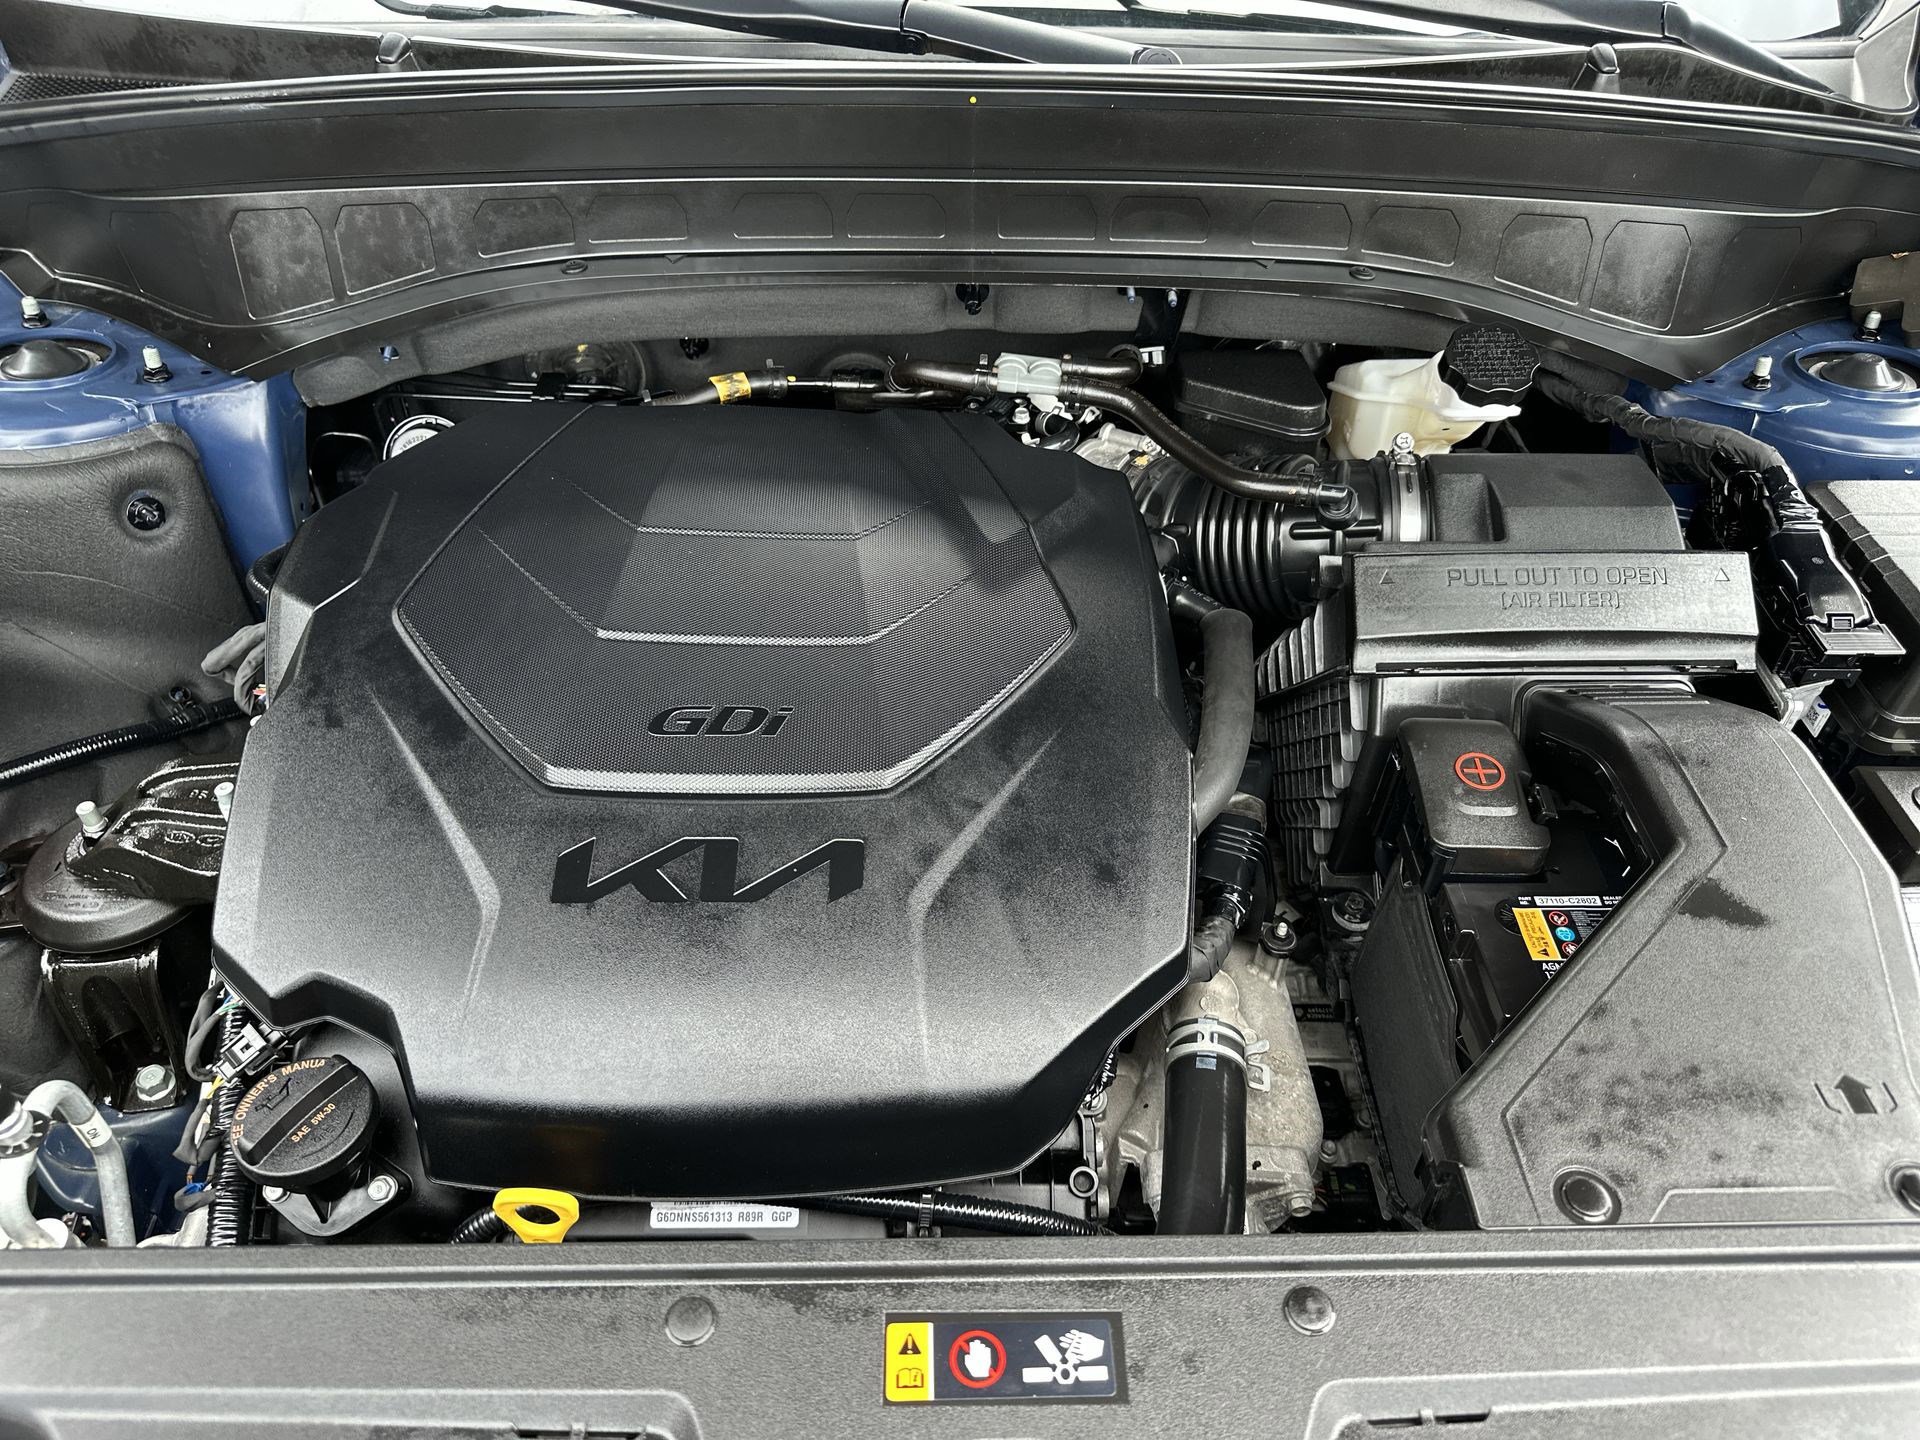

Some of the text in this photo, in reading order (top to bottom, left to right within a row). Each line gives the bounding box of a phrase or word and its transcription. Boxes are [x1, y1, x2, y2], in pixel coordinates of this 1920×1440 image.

[1447, 566, 1668, 587] PULL OUT TO OPEN
[648, 704, 795, 737] GDi
[551, 836, 865, 903] KIA
[235, 1073, 278, 1121] OWNER'S
[291, 1103, 336, 1143] SAE 5W-30
[656, 1210, 793, 1223] G6DNNS561313 R89R GGP
